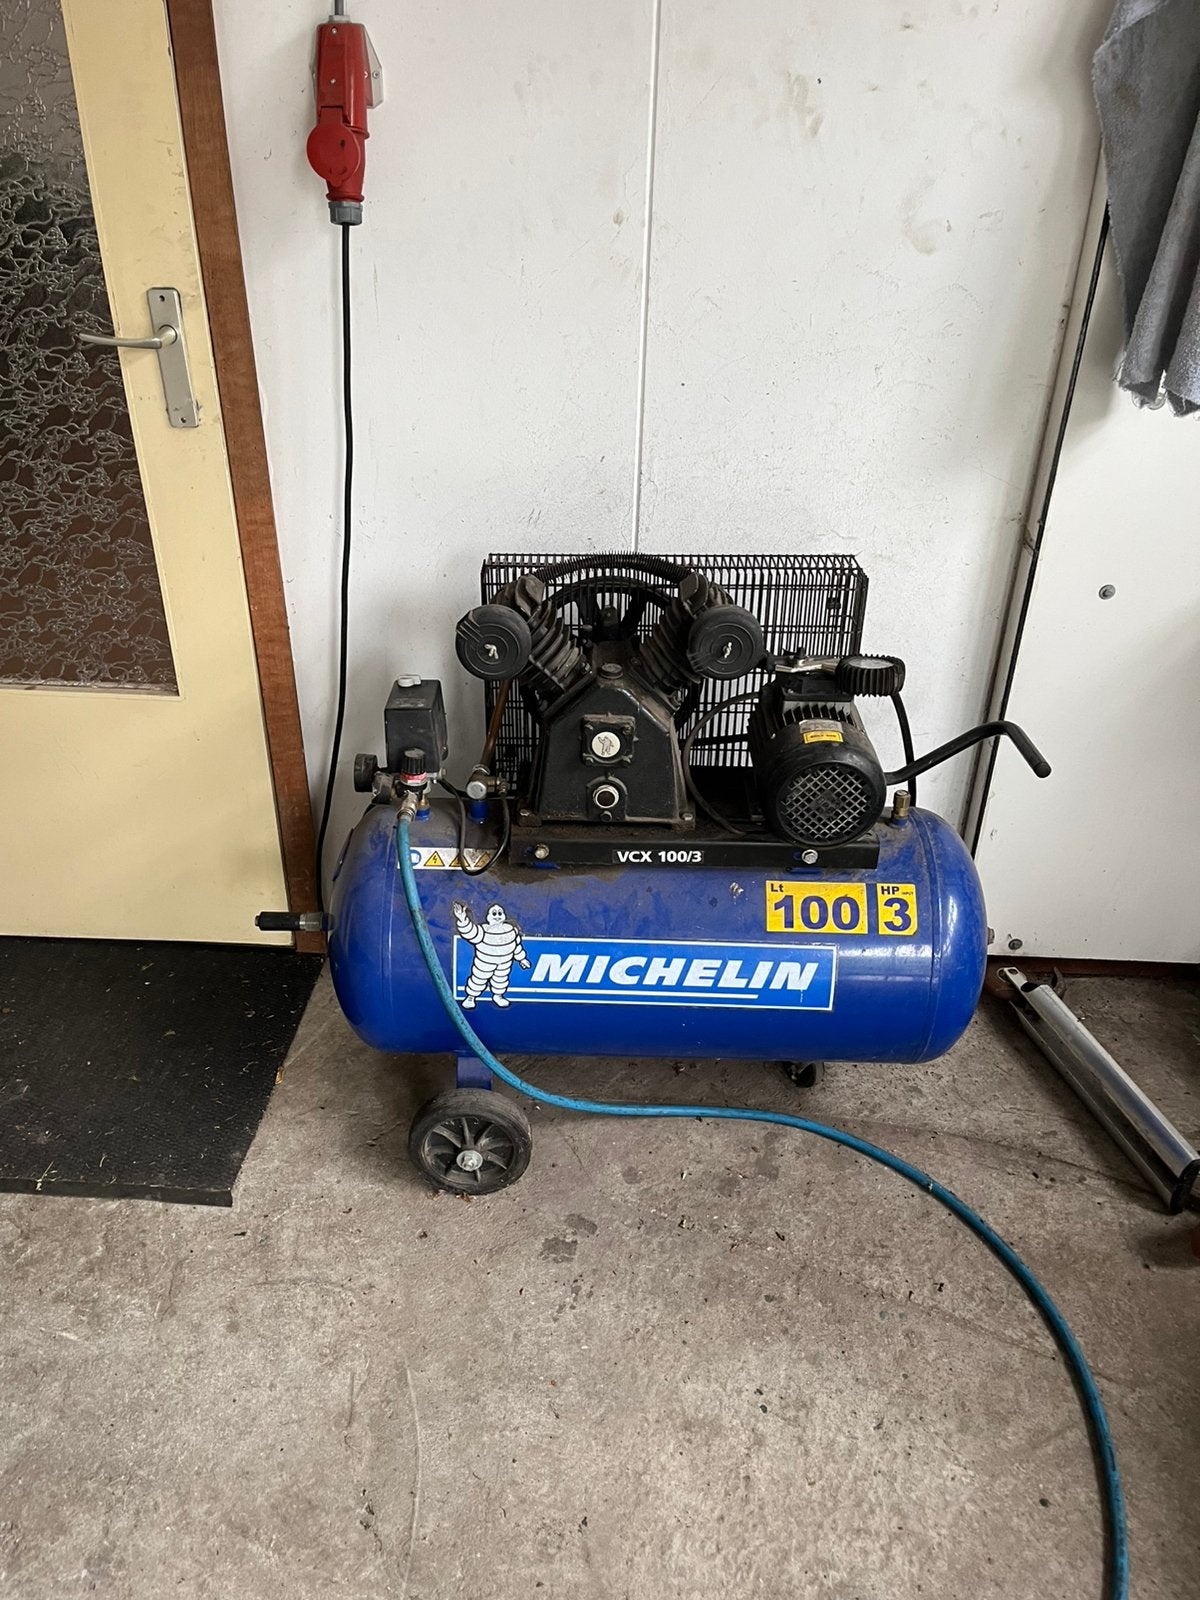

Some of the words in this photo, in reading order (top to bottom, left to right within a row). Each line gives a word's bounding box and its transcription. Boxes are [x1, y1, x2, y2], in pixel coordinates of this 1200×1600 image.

[617, 850, 653, 863] VCX
[658, 850, 702, 863] 100/3
[770, 883, 784, 893] Lt
[881, 885, 900, 896] HP
[774, 894, 860, 931] 100
[883, 897, 912, 932] 3
[530, 953, 819, 991] MICHELIN
